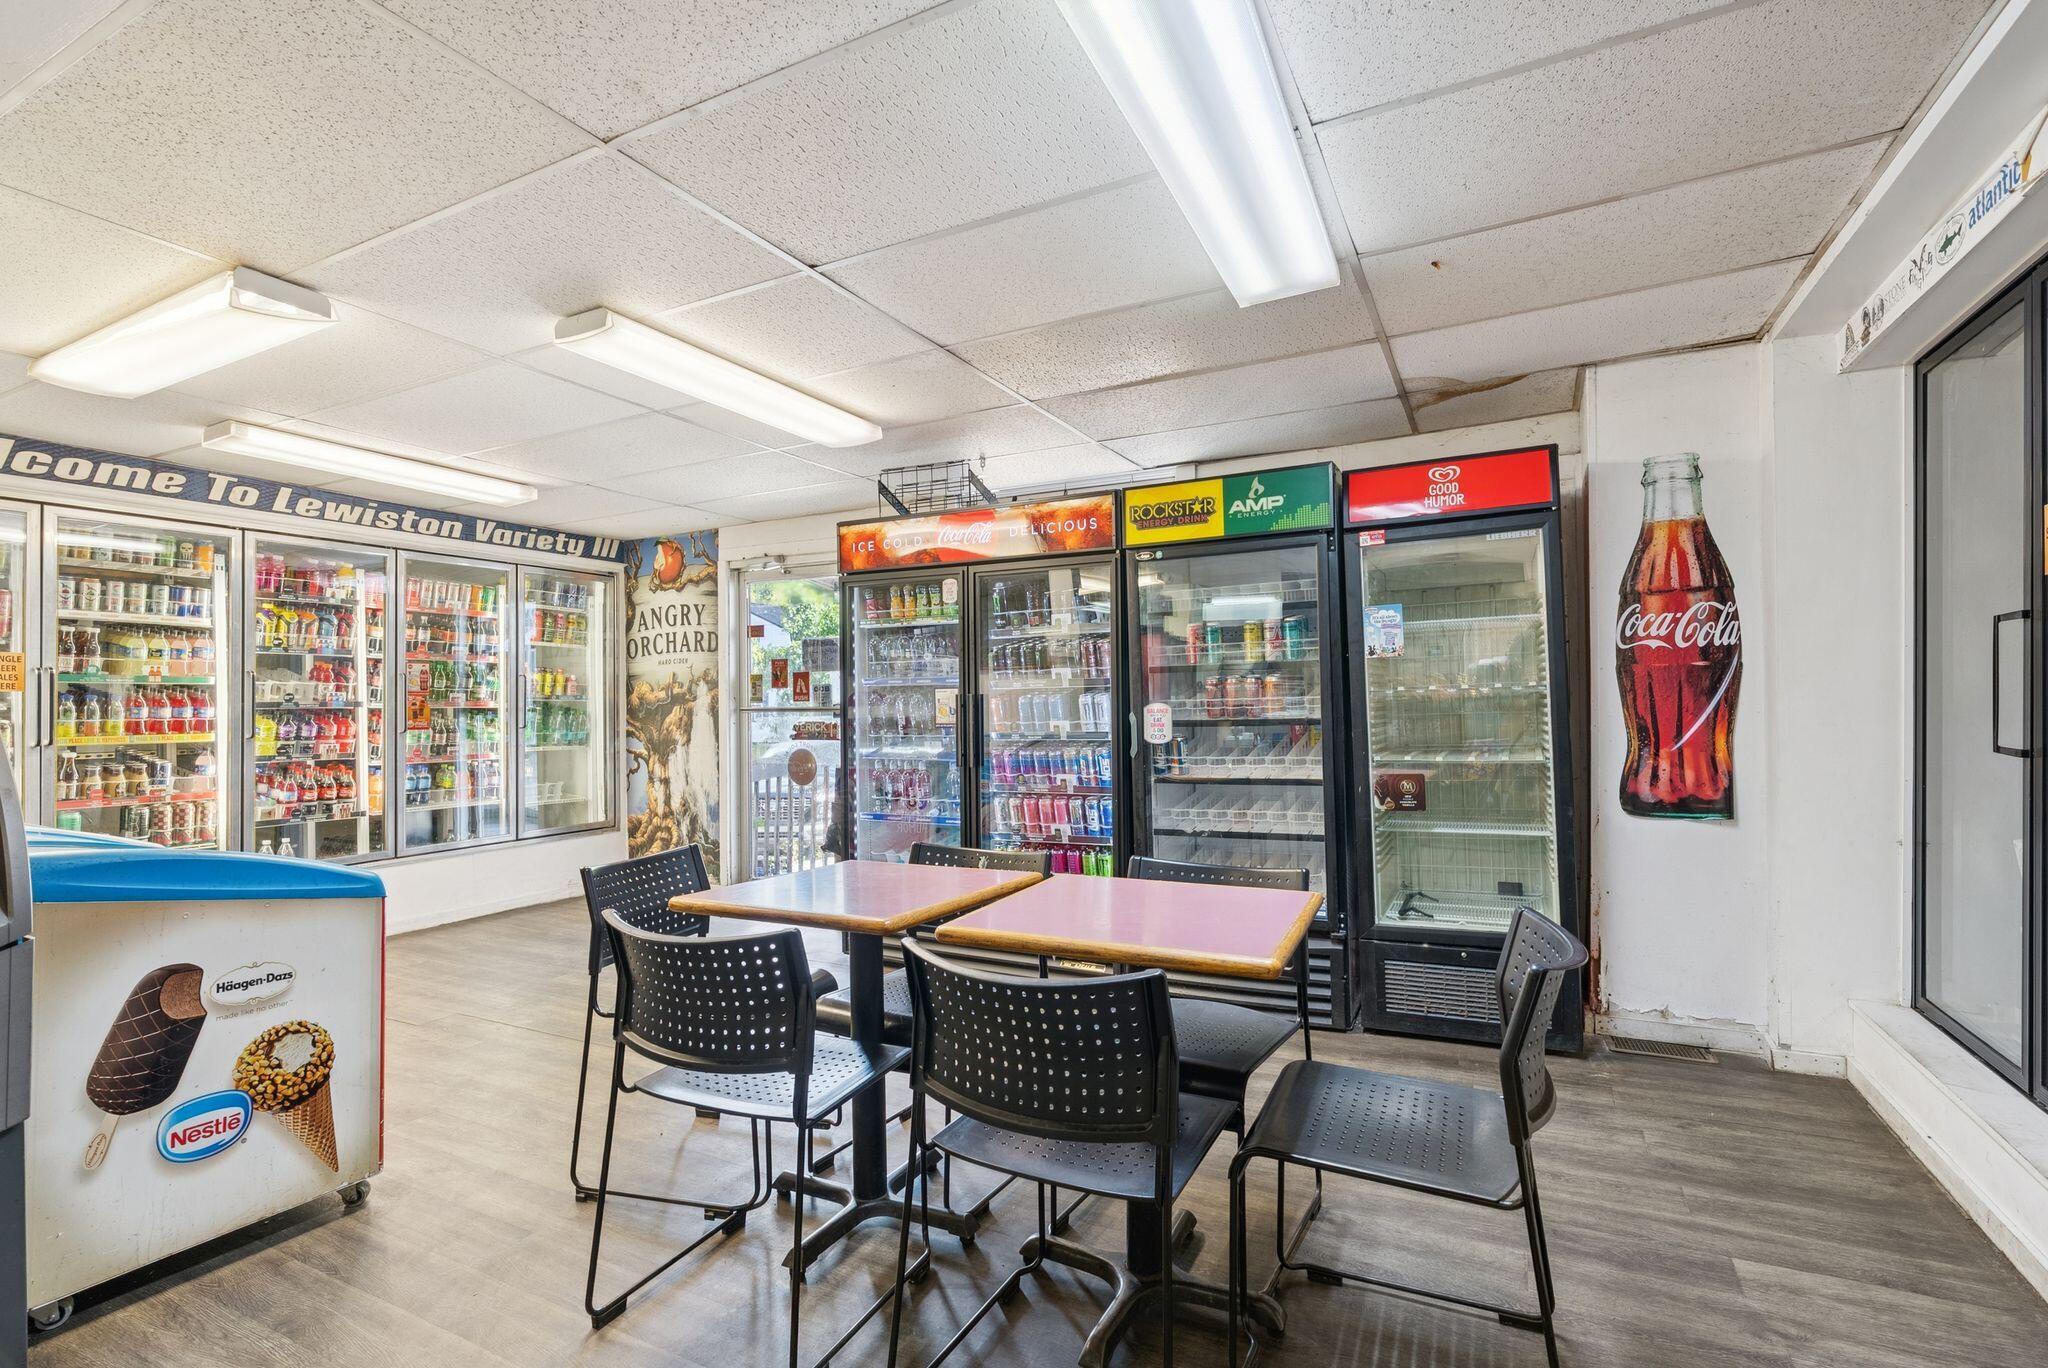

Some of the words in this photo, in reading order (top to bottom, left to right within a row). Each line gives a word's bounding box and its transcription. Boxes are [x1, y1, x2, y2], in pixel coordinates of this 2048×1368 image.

[1428, 482, 1459, 496] GOOD
[1228, 495, 1285, 514] AMP
[1423, 493, 1465, 508] HUMOR
[207, 472, 260, 506] To
[271, 486, 464, 539] Lewiston
[475, 519, 584, 557] Variety
[1137, 517, 1174, 529] ENERGY
[1177, 513, 1209, 525] DRINK
[1237, 509, 1276, 519] ENERGY
[852, 541, 875, 554] ICE
[883, 535, 923, 551] COLD
[1009, 516, 1099, 538] DELICIOUS
[1486, 529, 1537, 541] LIEBHERR
[638, 604, 706, 632] ANGRY
[1617, 601, 1741, 650] Coca-Cola
[627, 631, 718, 659] ORCHARD
[216, 971, 294, 994] Häagen-Dazs
[216, 1012, 239, 1021] made
[241, 1008, 254, 1016] like
[256, 1005, 267, 1013] no
[268, 1001, 289, 1010] other
